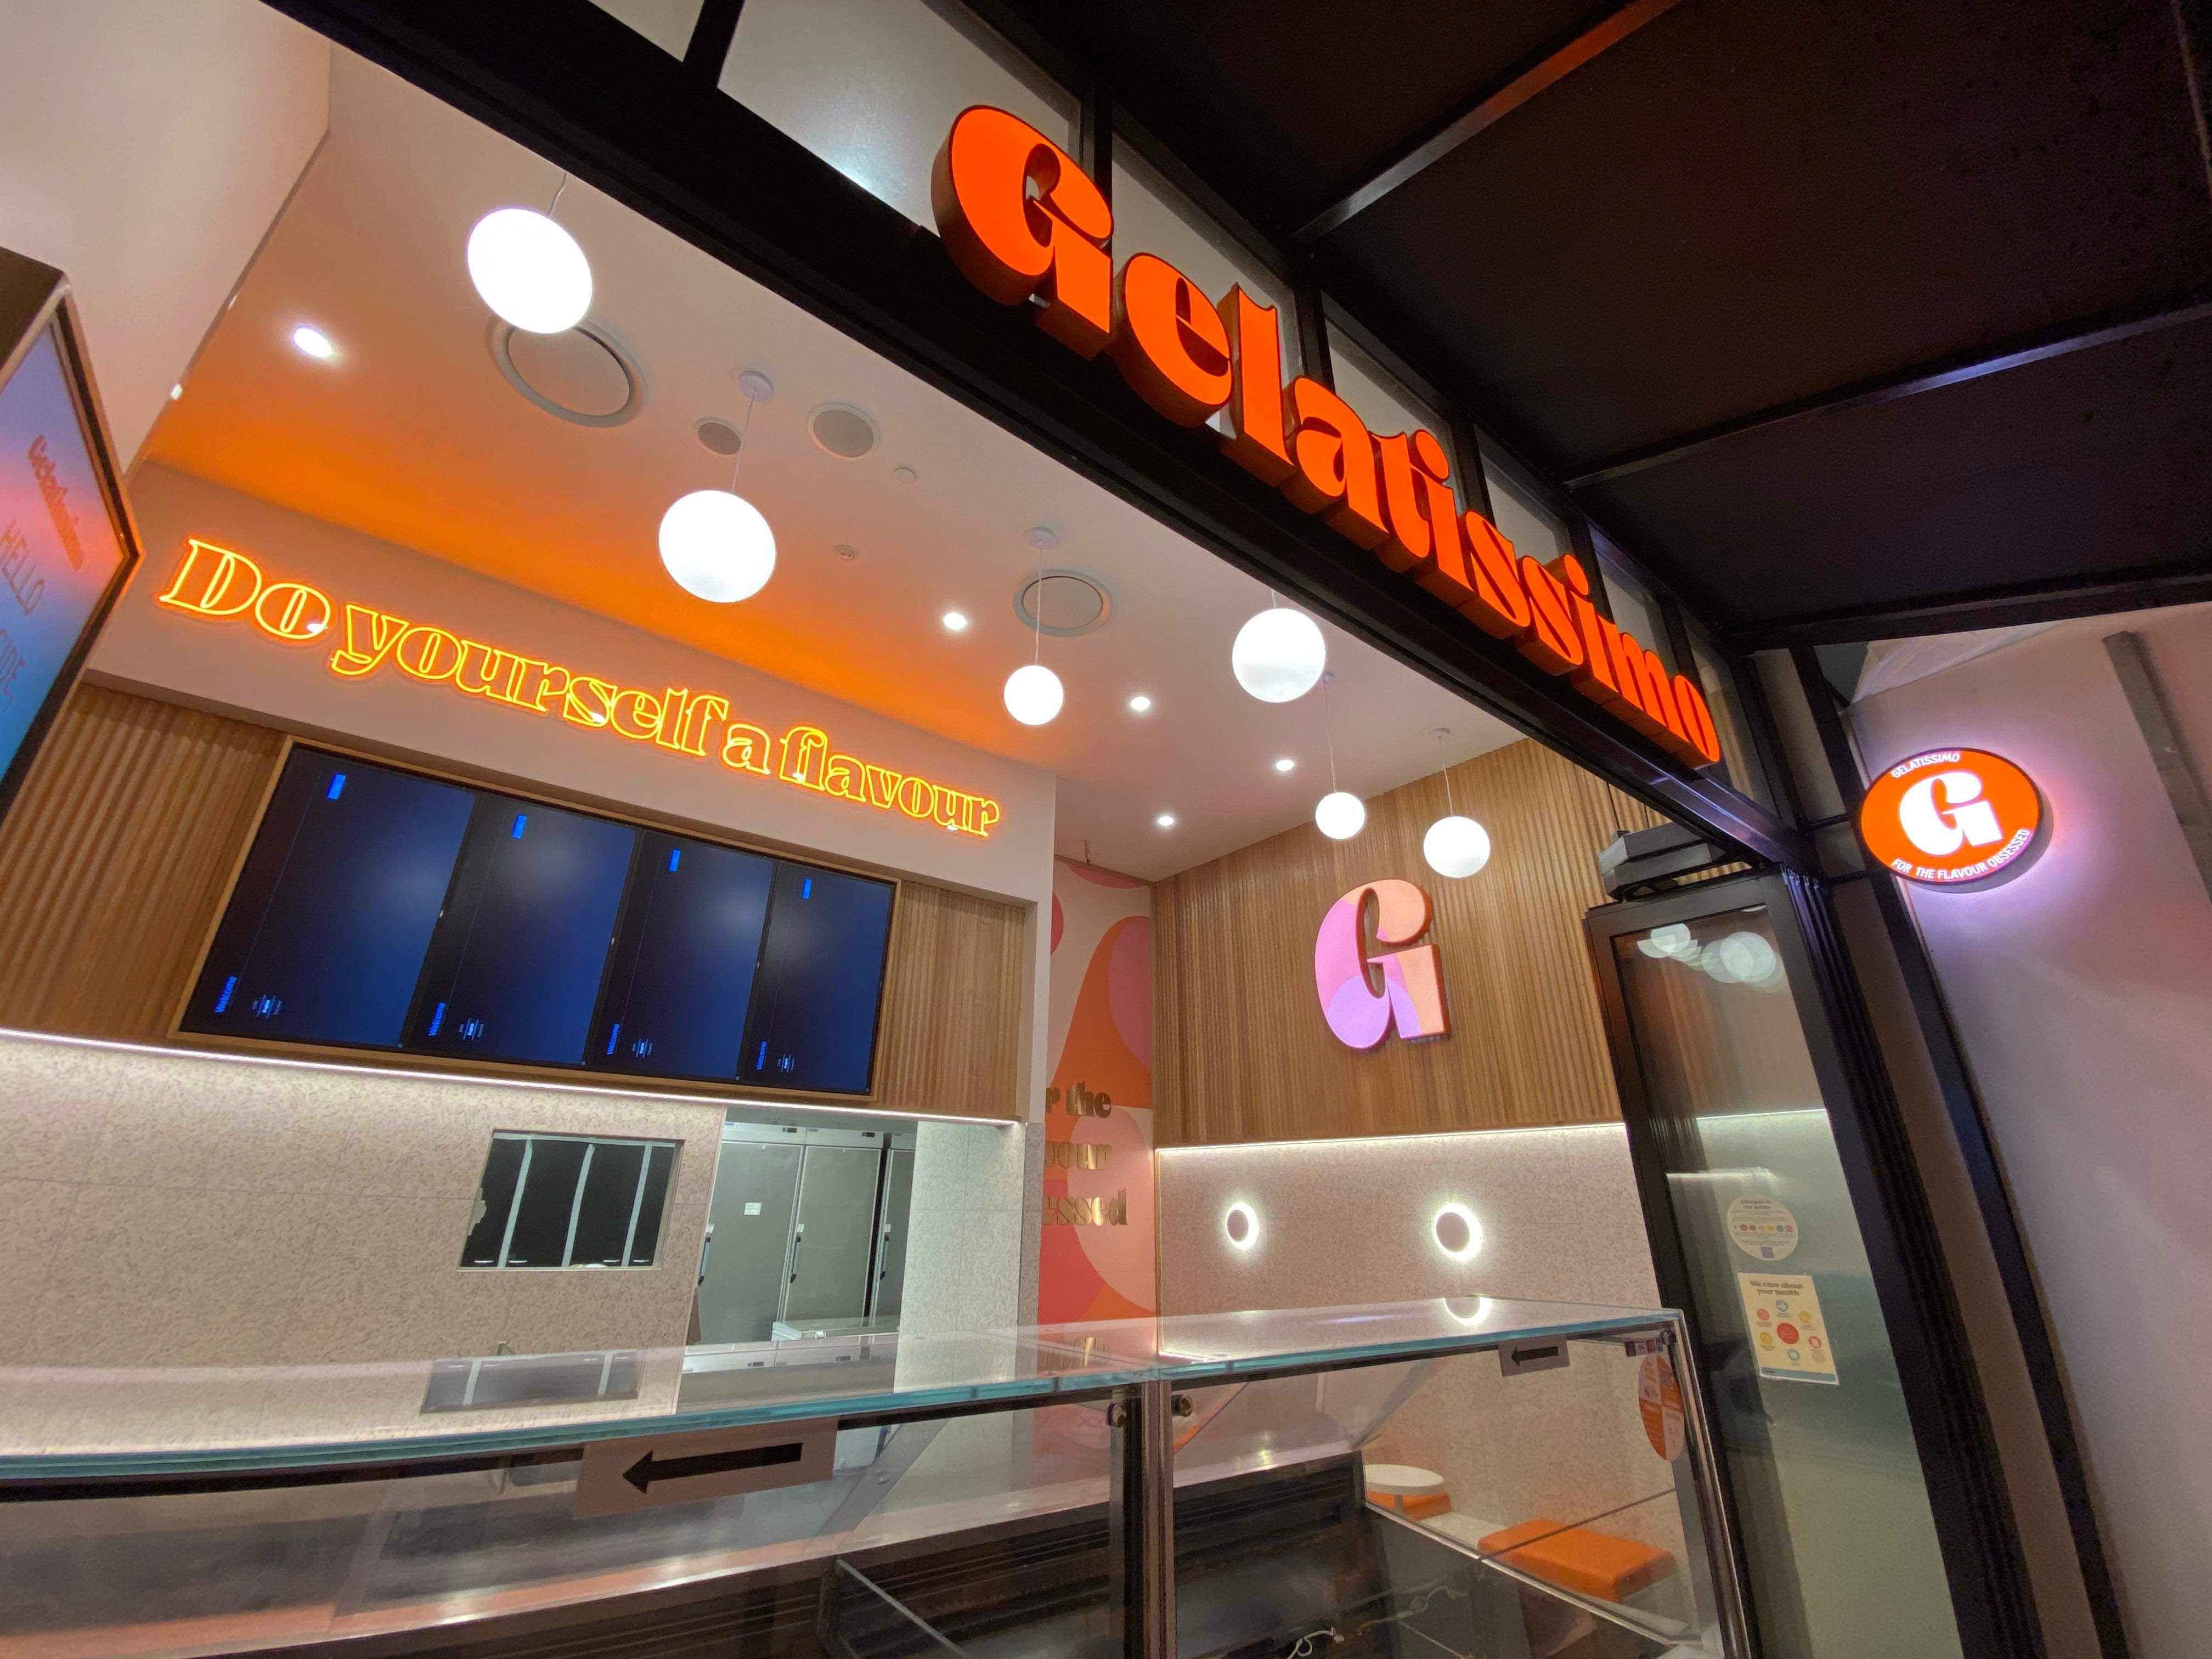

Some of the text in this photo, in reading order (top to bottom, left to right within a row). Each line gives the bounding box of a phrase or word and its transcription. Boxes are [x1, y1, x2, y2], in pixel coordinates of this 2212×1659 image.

[948, 106, 1721, 764] Gelatissimo
[157, 536, 1001, 838] Do yourself a flavour
[1891, 752, 1961, 778] GELATISSIMO
[1898, 771, 2004, 856] G
[1891, 828, 2031, 880] FOR THE FLAVOUR OBSESSED
[1314, 879, 1452, 1049] G
[214, 975, 237, 1014] Welcome
[428, 1001, 446, 1036] Welcome
[606, 1023, 620, 1055] Welcome
[755, 1040, 767, 1070] Welcome
[1066, 1081, 1112, 1119] the
[1775, 1289, 1800, 1297] health
[1781, 1282, 1804, 1290] about
